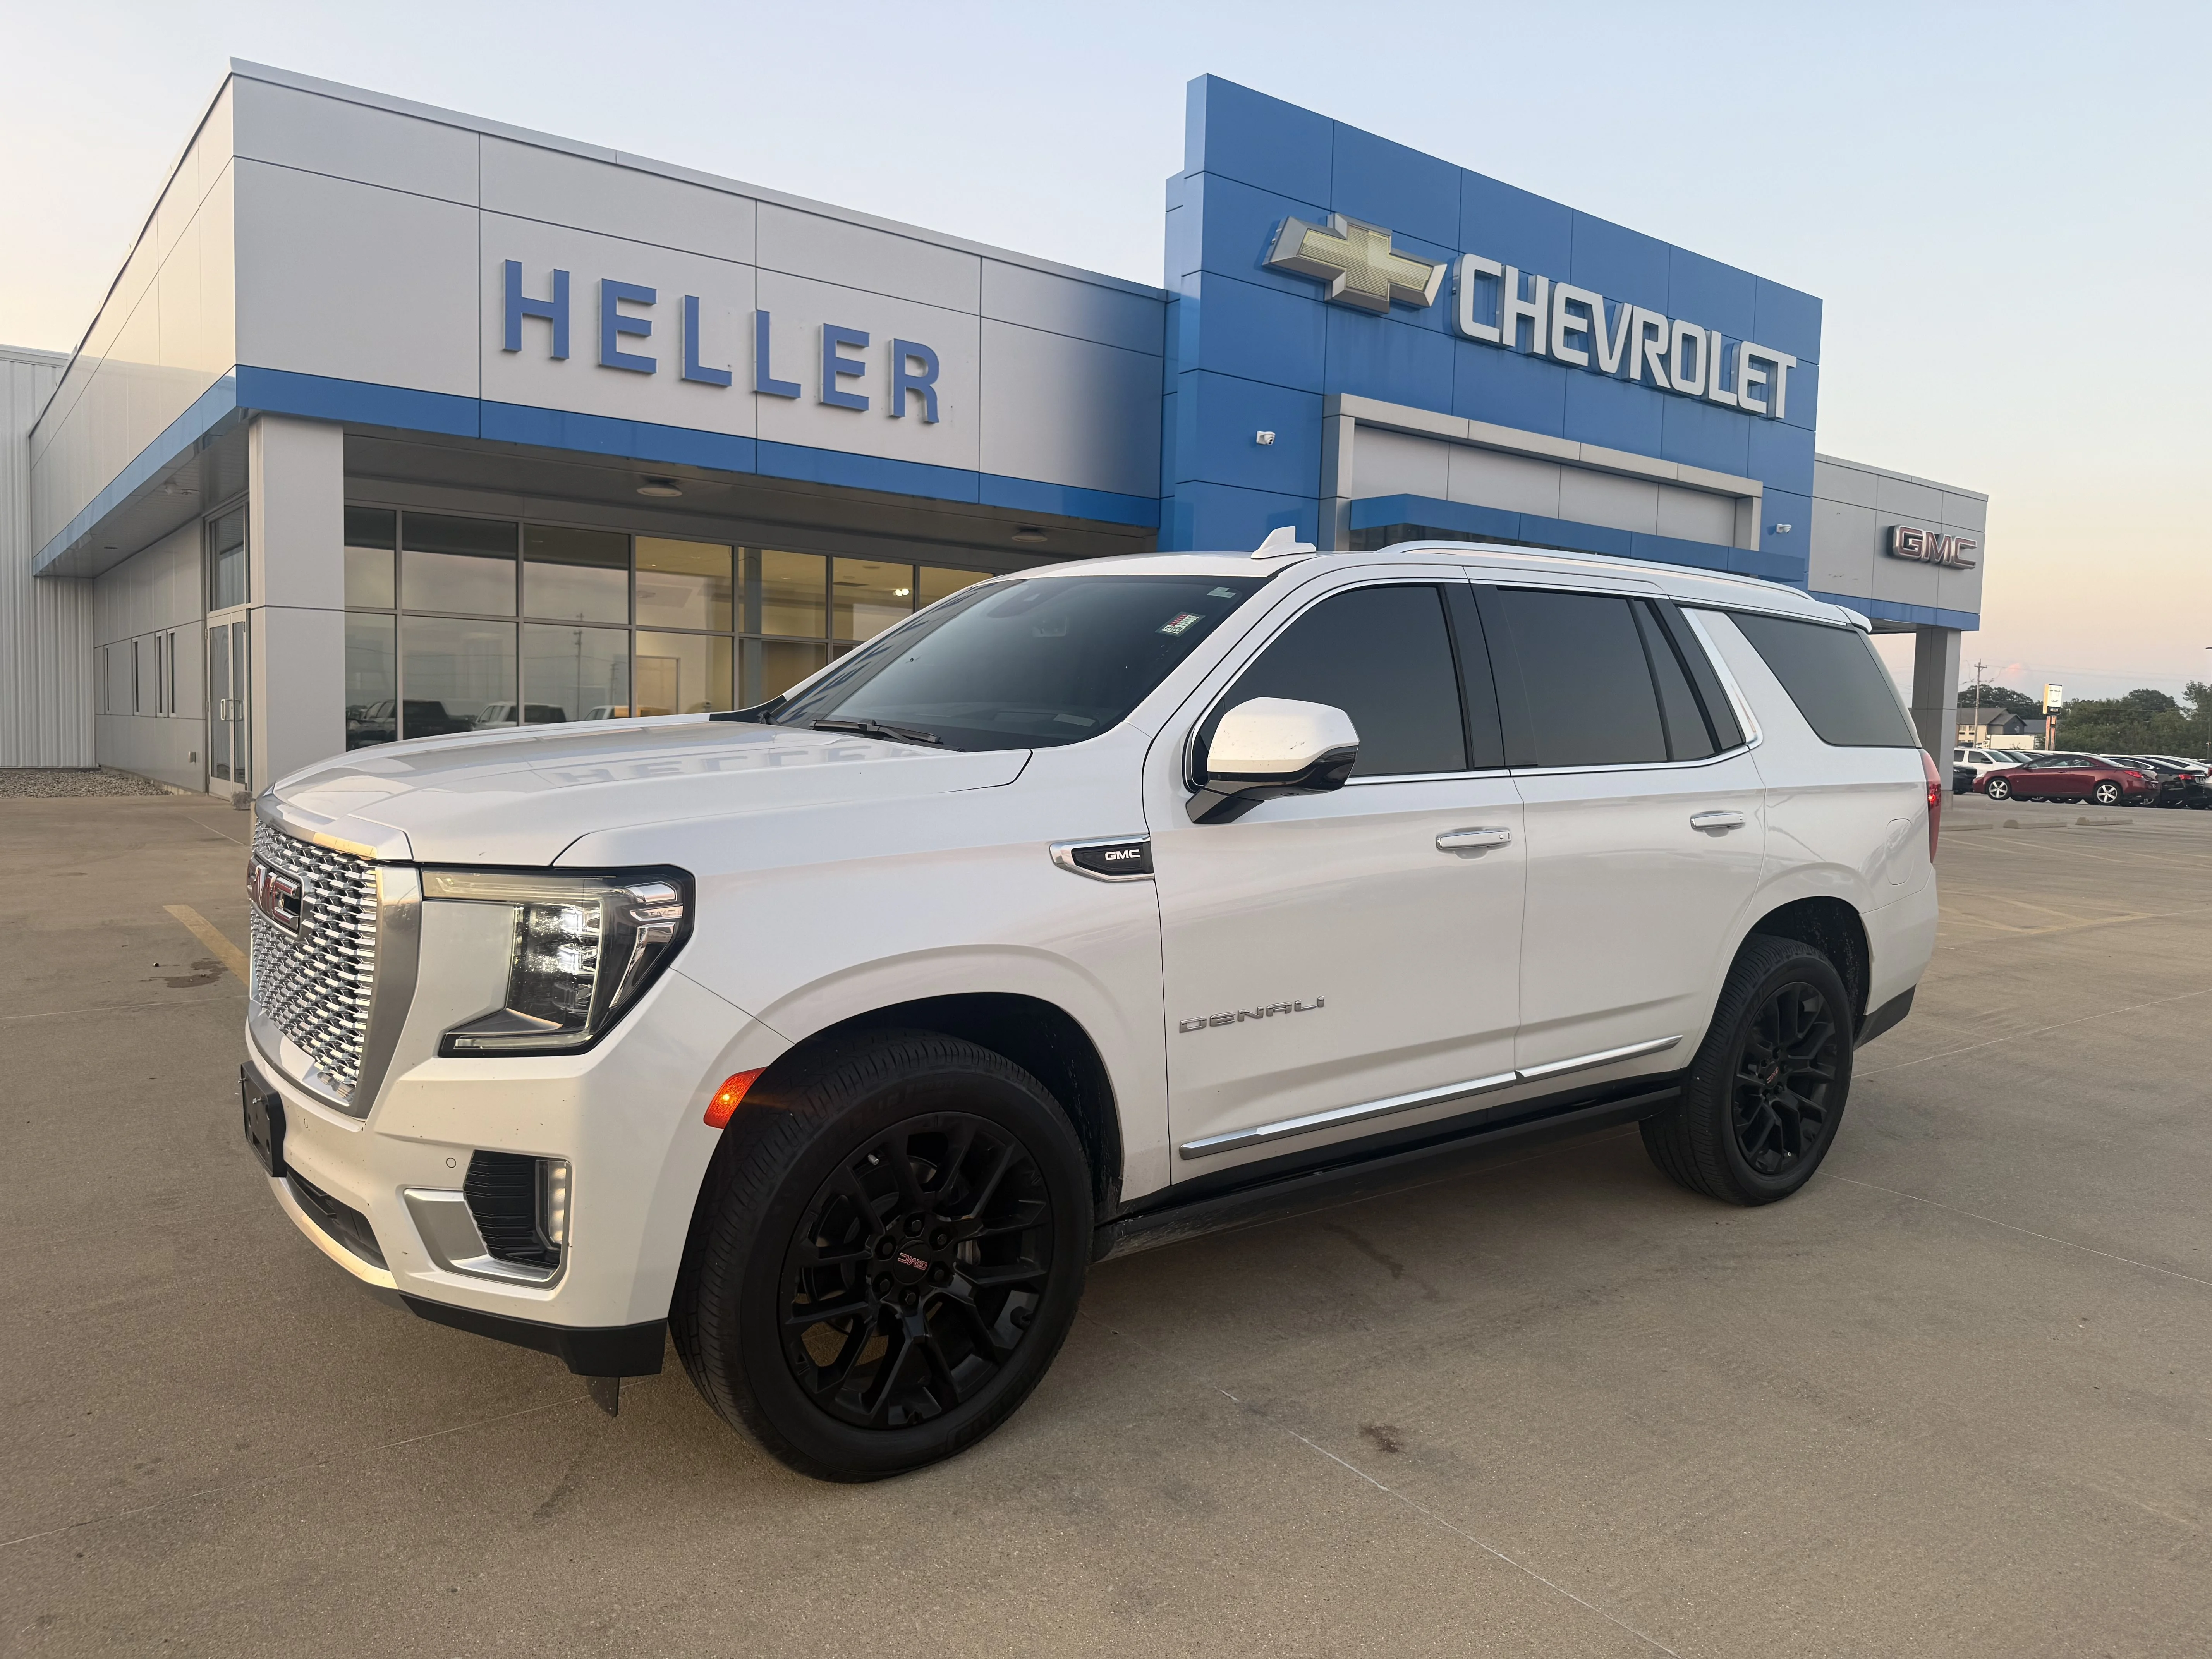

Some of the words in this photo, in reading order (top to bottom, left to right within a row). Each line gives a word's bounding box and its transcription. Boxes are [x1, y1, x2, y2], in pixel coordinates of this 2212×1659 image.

[502, 259, 939, 424] HELLER
[1453, 253, 1797, 419] CHEVROLET
[1893, 525, 1977, 568] GMC
[1105, 849, 1140, 860] GMC
[1179, 995, 1325, 1033] DENALI
[898, 1252, 928, 1270] GMC
